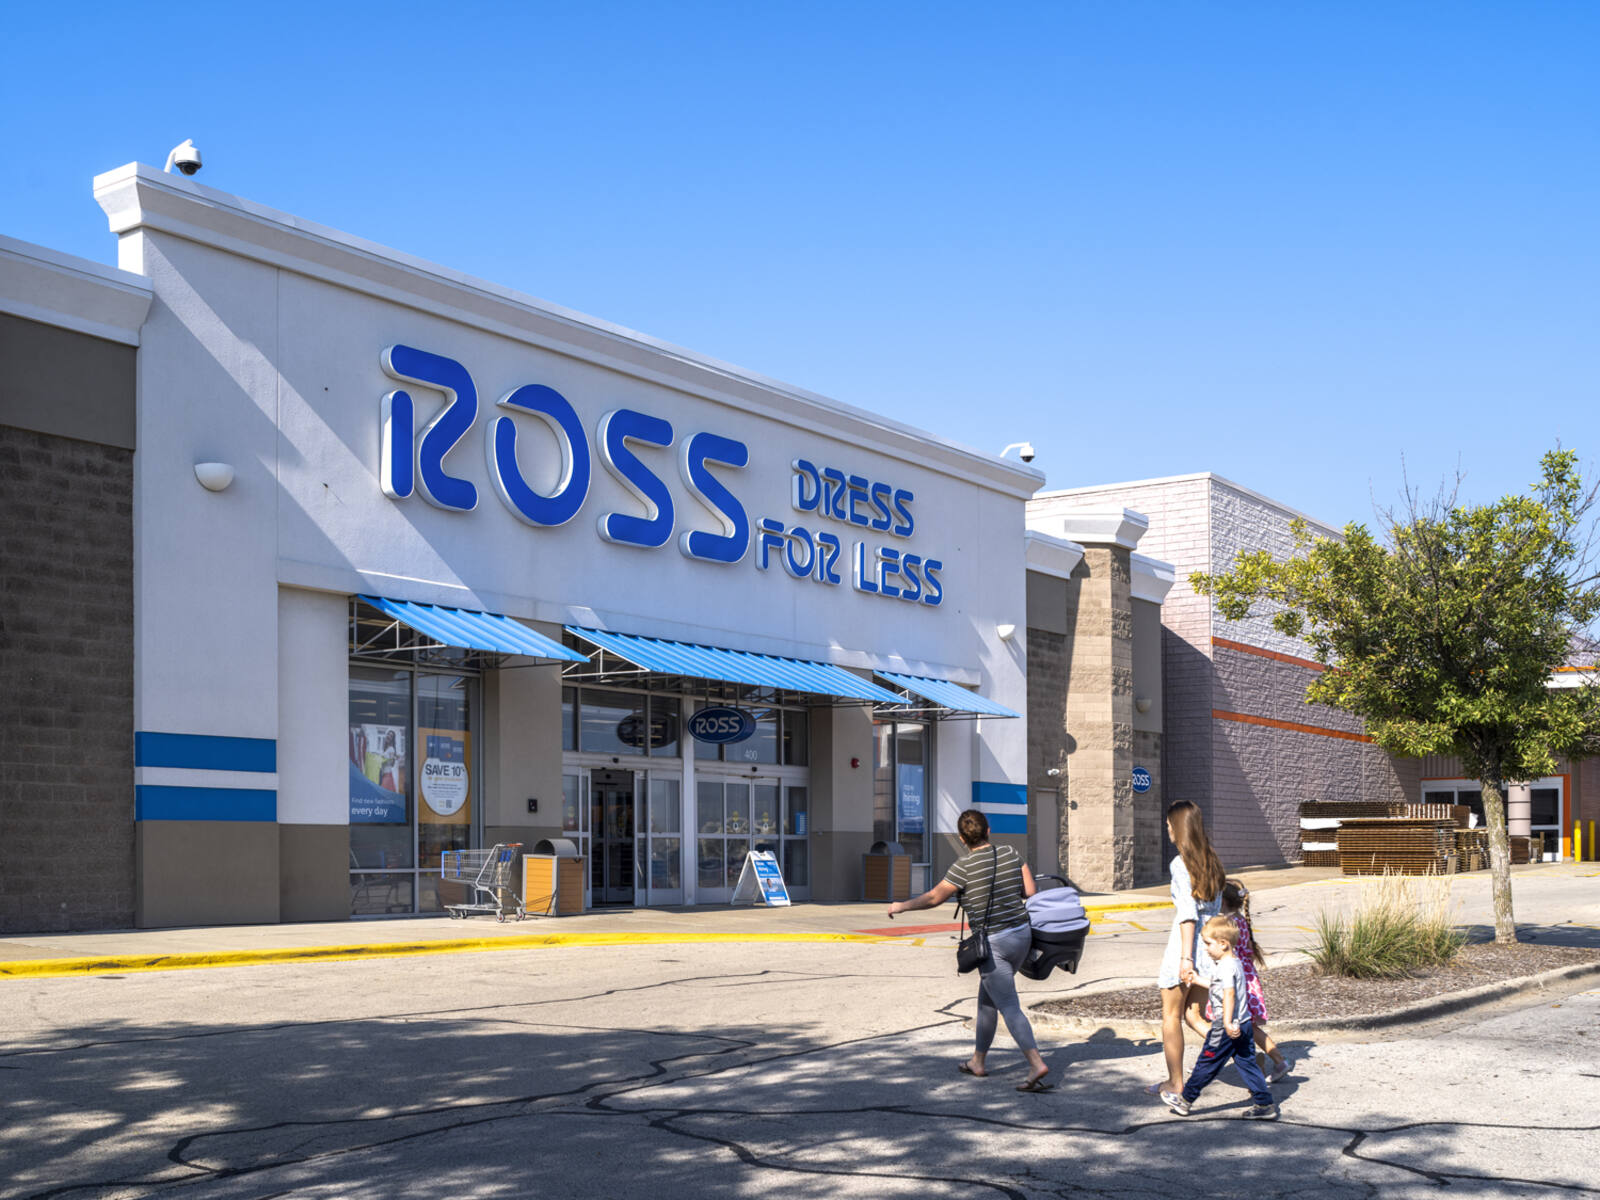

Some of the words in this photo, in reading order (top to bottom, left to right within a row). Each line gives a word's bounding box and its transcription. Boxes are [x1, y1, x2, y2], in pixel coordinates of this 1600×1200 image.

[381, 344, 750, 564] ROSS
[792, 458, 915, 538] DRESS
[756, 518, 842, 585] FOR
[854, 541, 944, 606] LESS
[695, 716, 740, 734] ROSS
[744, 748, 758, 760] 400
[425, 763, 450, 776] SAVE
[351, 807, 373, 817] every
[374, 805, 389, 818] day
